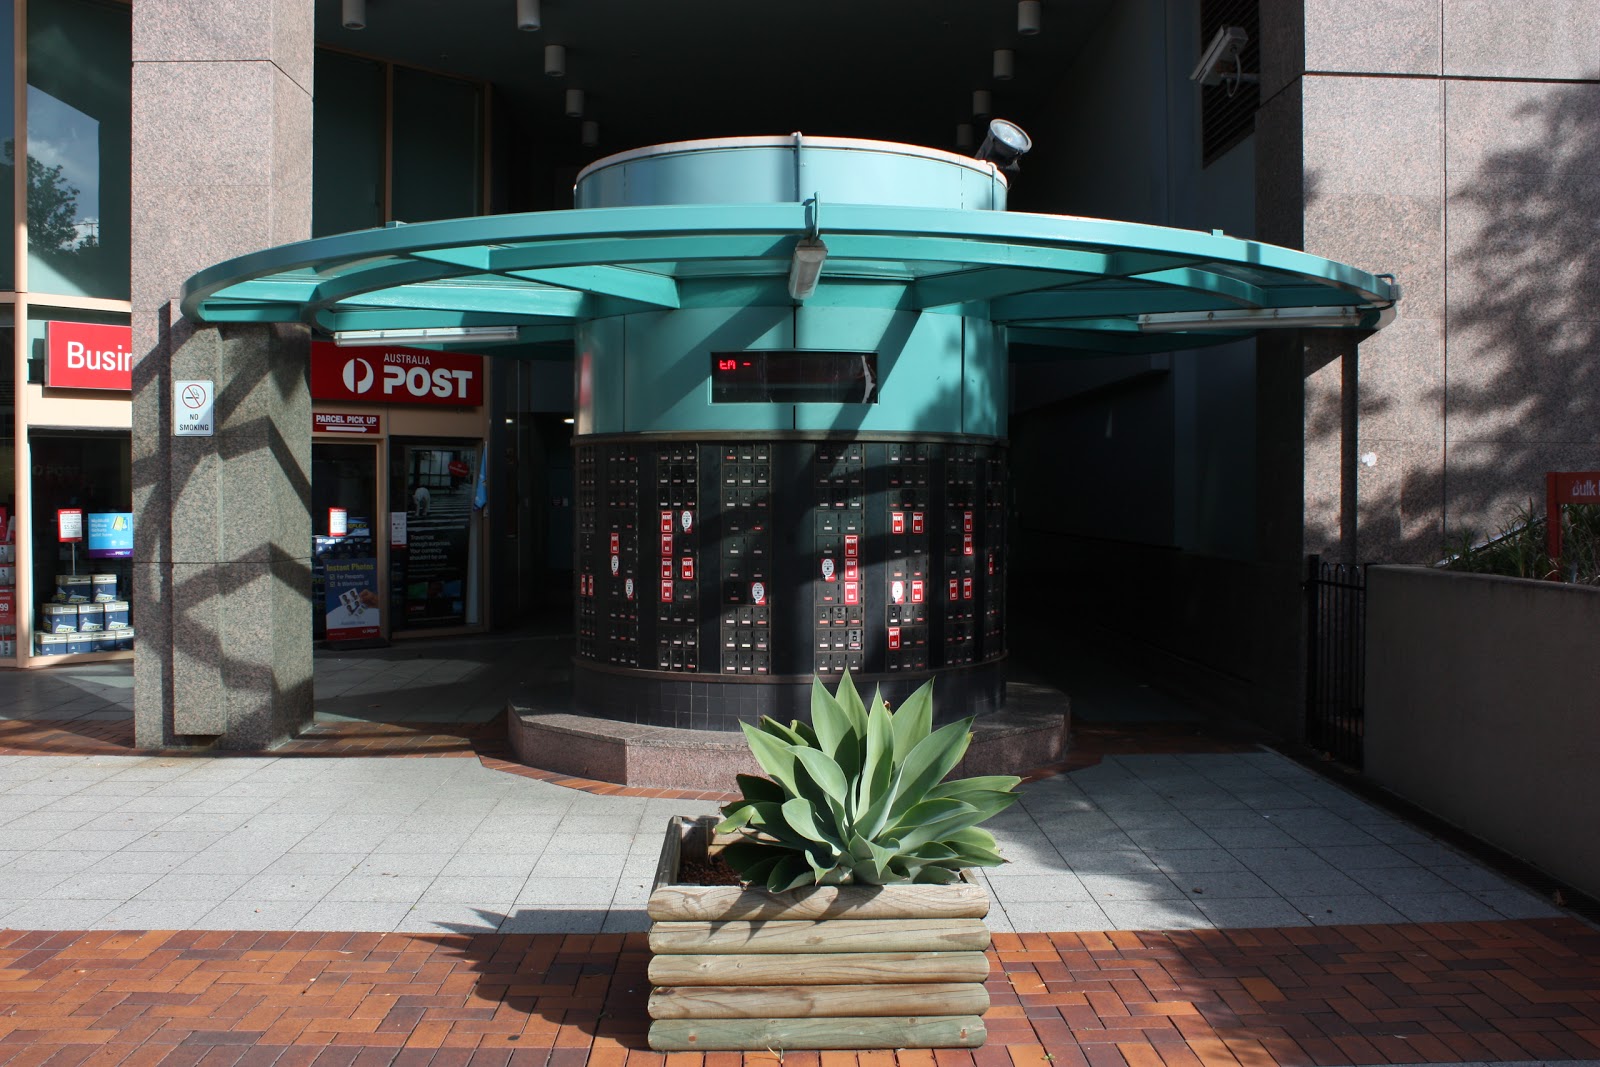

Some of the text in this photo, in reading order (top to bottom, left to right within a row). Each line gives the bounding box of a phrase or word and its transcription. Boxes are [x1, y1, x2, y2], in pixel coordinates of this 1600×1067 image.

[384, 353, 431, 365] AUSTRALIA
[383, 365, 473, 399] POST
[189, 413, 199, 421] NO
[315, 414, 377, 425] PARCEL PICK UP
[179, 423, 210, 431] SMOKING
[1572, 479, 1596, 497] Bulk
[327, 563, 375, 572] Instant Photos
